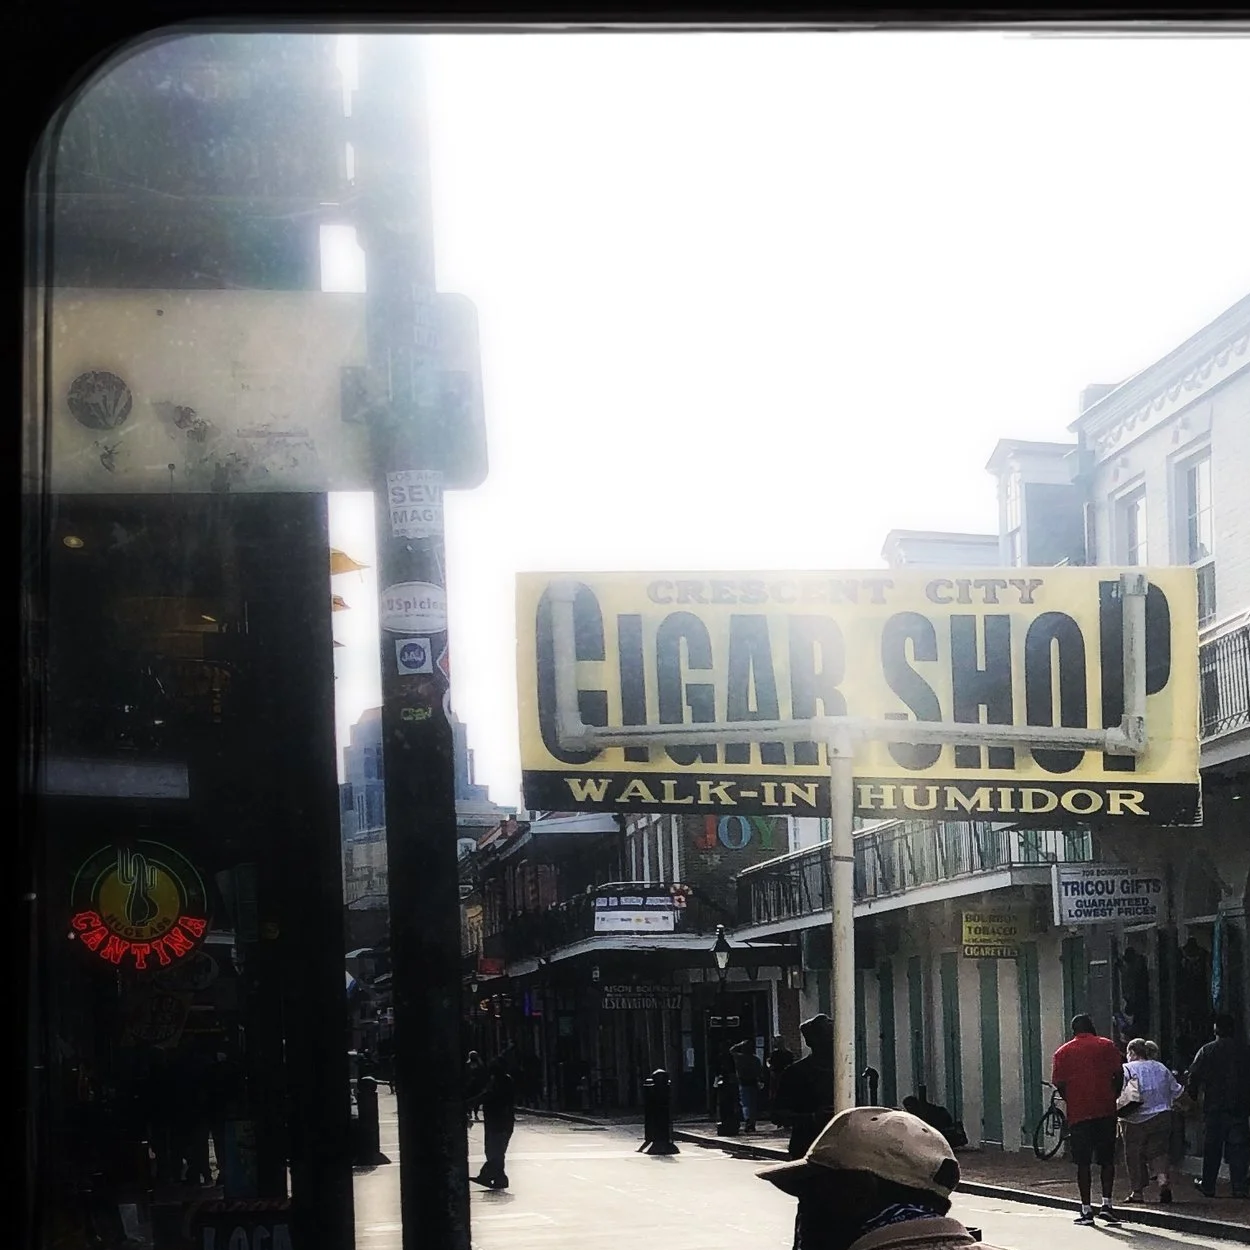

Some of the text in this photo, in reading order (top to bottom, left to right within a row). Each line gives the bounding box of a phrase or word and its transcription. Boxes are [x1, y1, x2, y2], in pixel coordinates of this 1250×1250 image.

[391, 485, 442, 504] SEV
[392, 510, 440, 524] MAG
[646, 578, 1044, 605] CRESCENT CITY
[536, 580, 1172, 774] CIGAR SHOP
[563, 777, 1150, 817] WALK-IN HUMIDOR
[694, 814, 778, 850] JOY
[1061, 878, 1161, 897] TRICOU GIFTS
[1068, 906, 1157, 918] LOWEST PRICES
[1075, 898, 1150, 909] GUARANTEED
[106, 914, 172, 938] HUGE ASS
[69, 909, 208, 970] CANTINA
